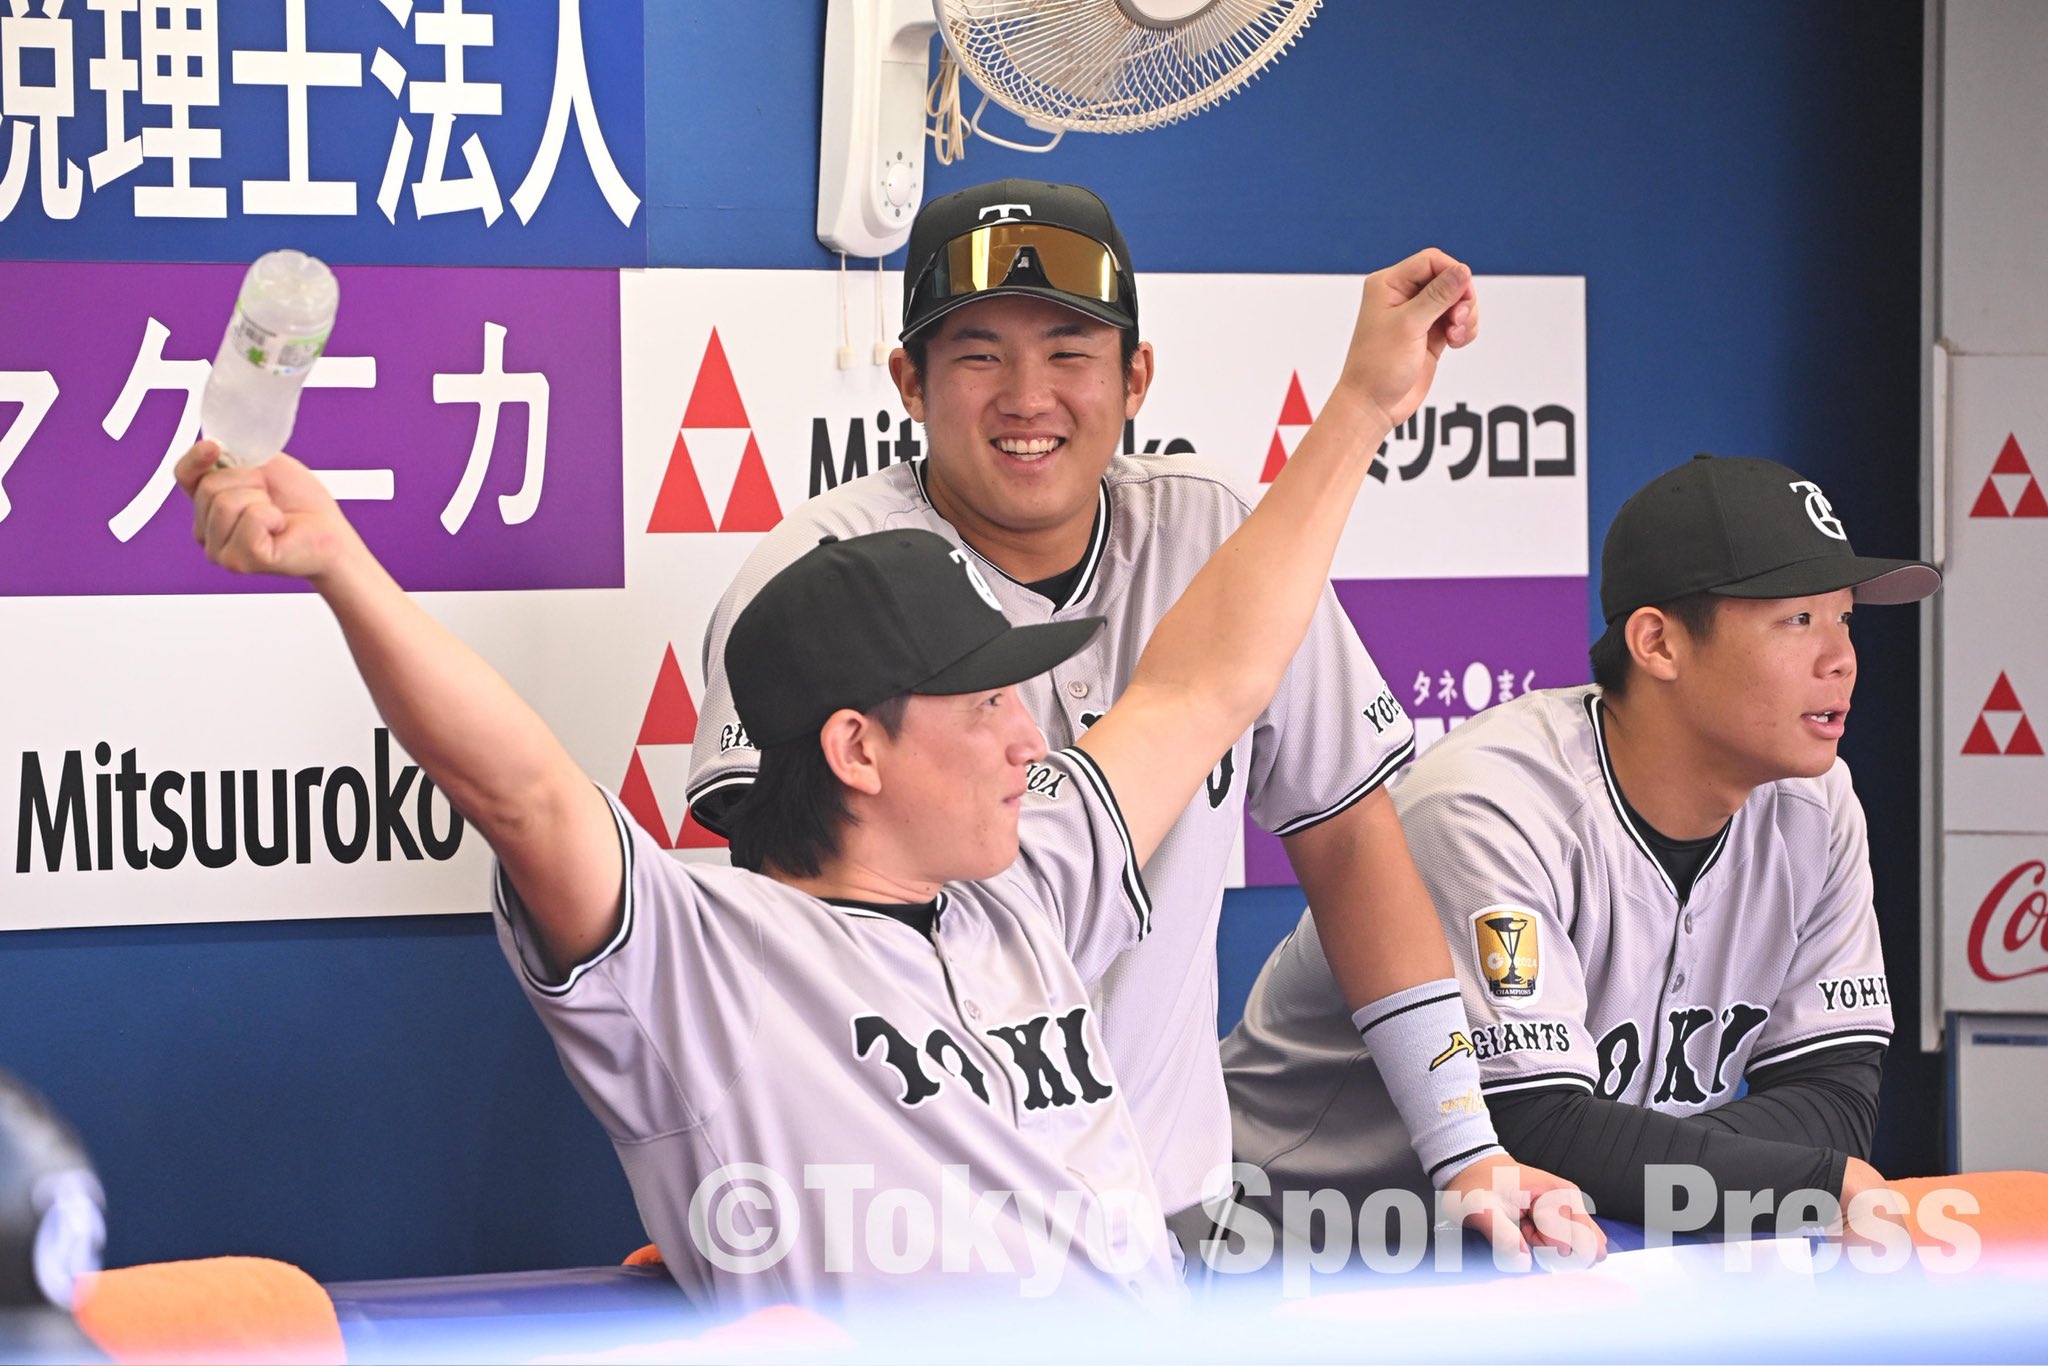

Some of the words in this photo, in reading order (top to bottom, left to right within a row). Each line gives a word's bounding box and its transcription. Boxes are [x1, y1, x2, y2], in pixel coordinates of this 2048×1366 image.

[15, 728, 466, 873] Mitsuuroko
[1967, 859, 2048, 984] Co
[1495, 988, 1532, 996] CHAMPIONS
[1470, 1022, 1571, 1061] GIANTS
